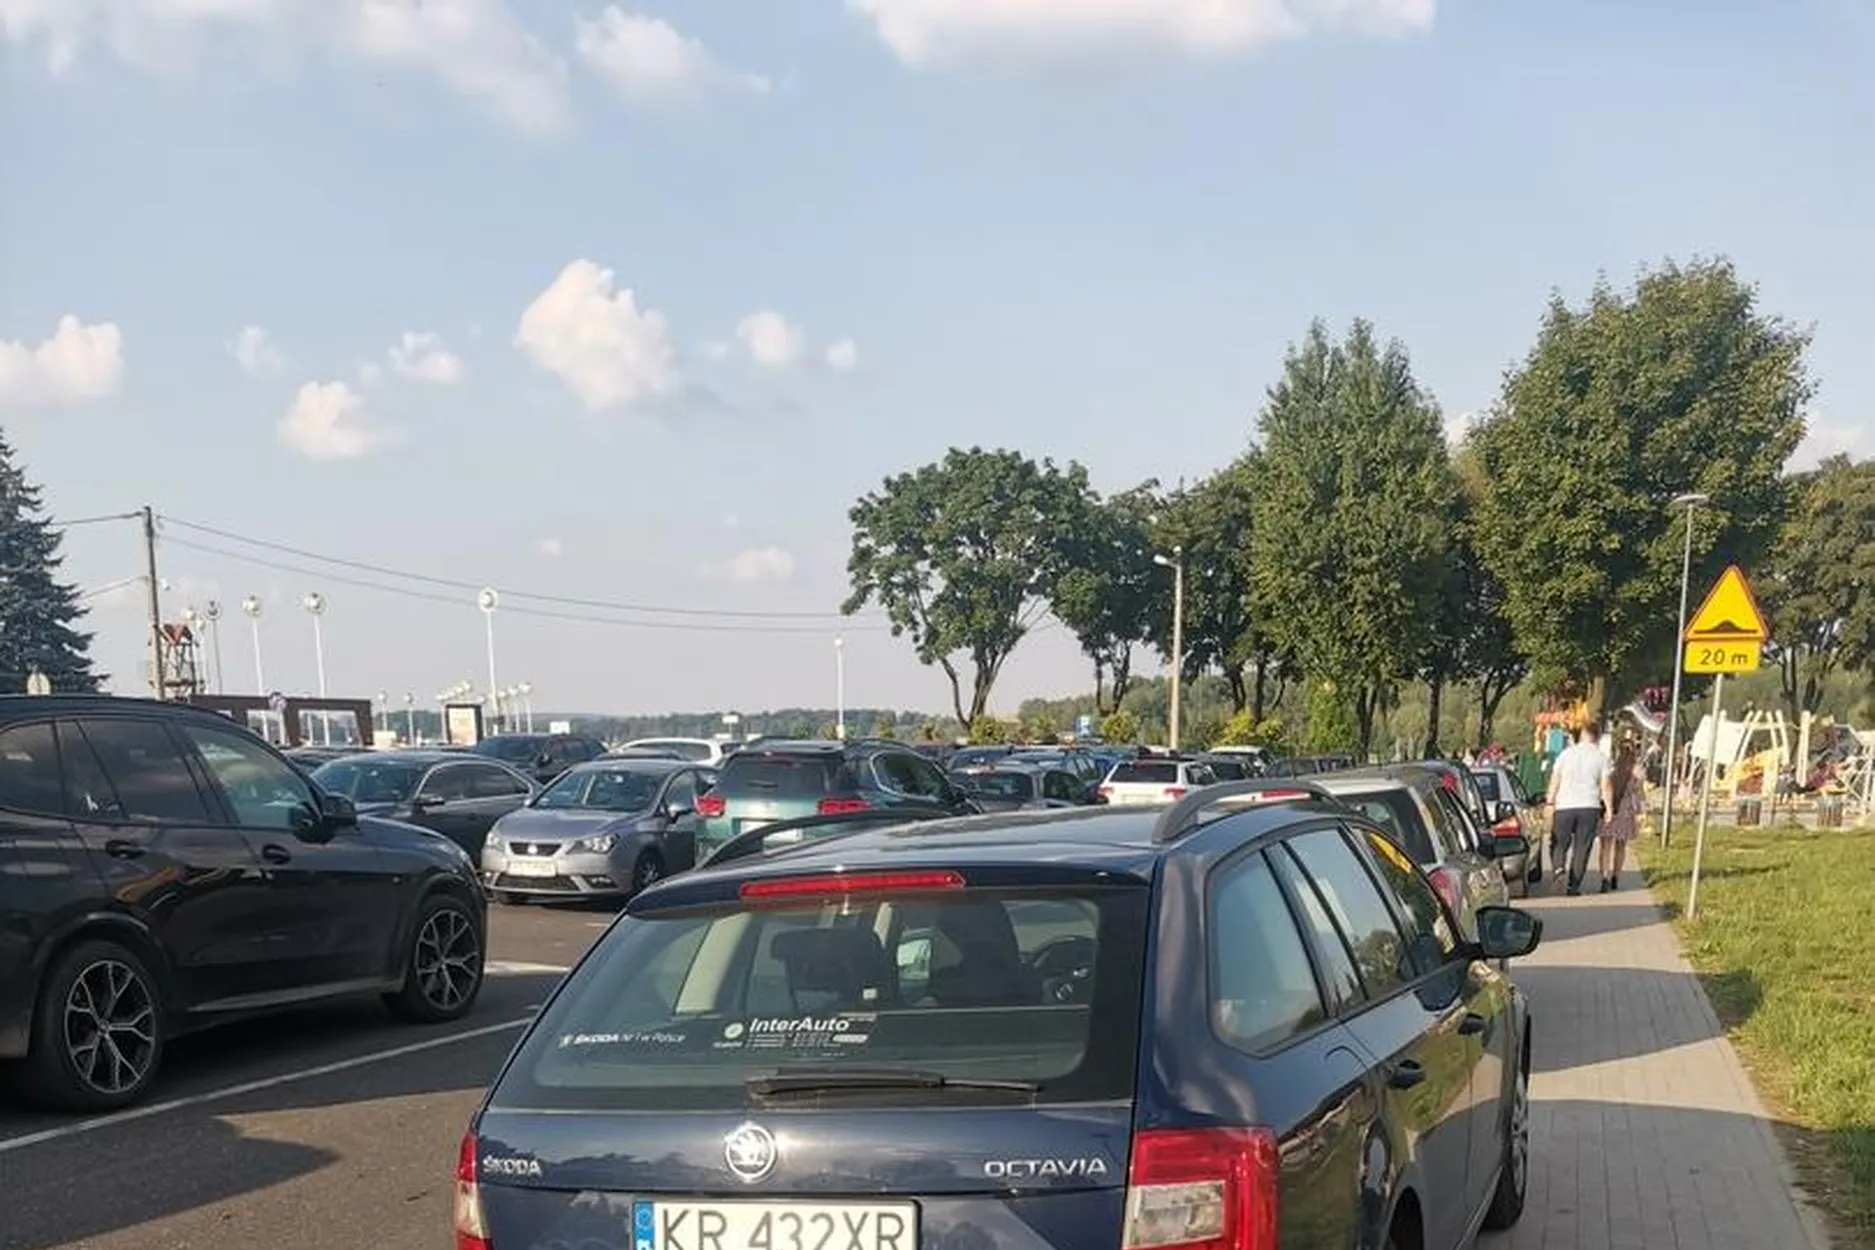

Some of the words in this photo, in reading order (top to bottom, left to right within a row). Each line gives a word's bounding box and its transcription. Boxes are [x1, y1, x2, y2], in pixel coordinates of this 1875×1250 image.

[1699, 649, 1725, 665] 20
[1731, 653, 1748, 665] m
[749, 1016, 850, 1033] InterAuto
[984, 1158, 1107, 1177] OCTAVIA
